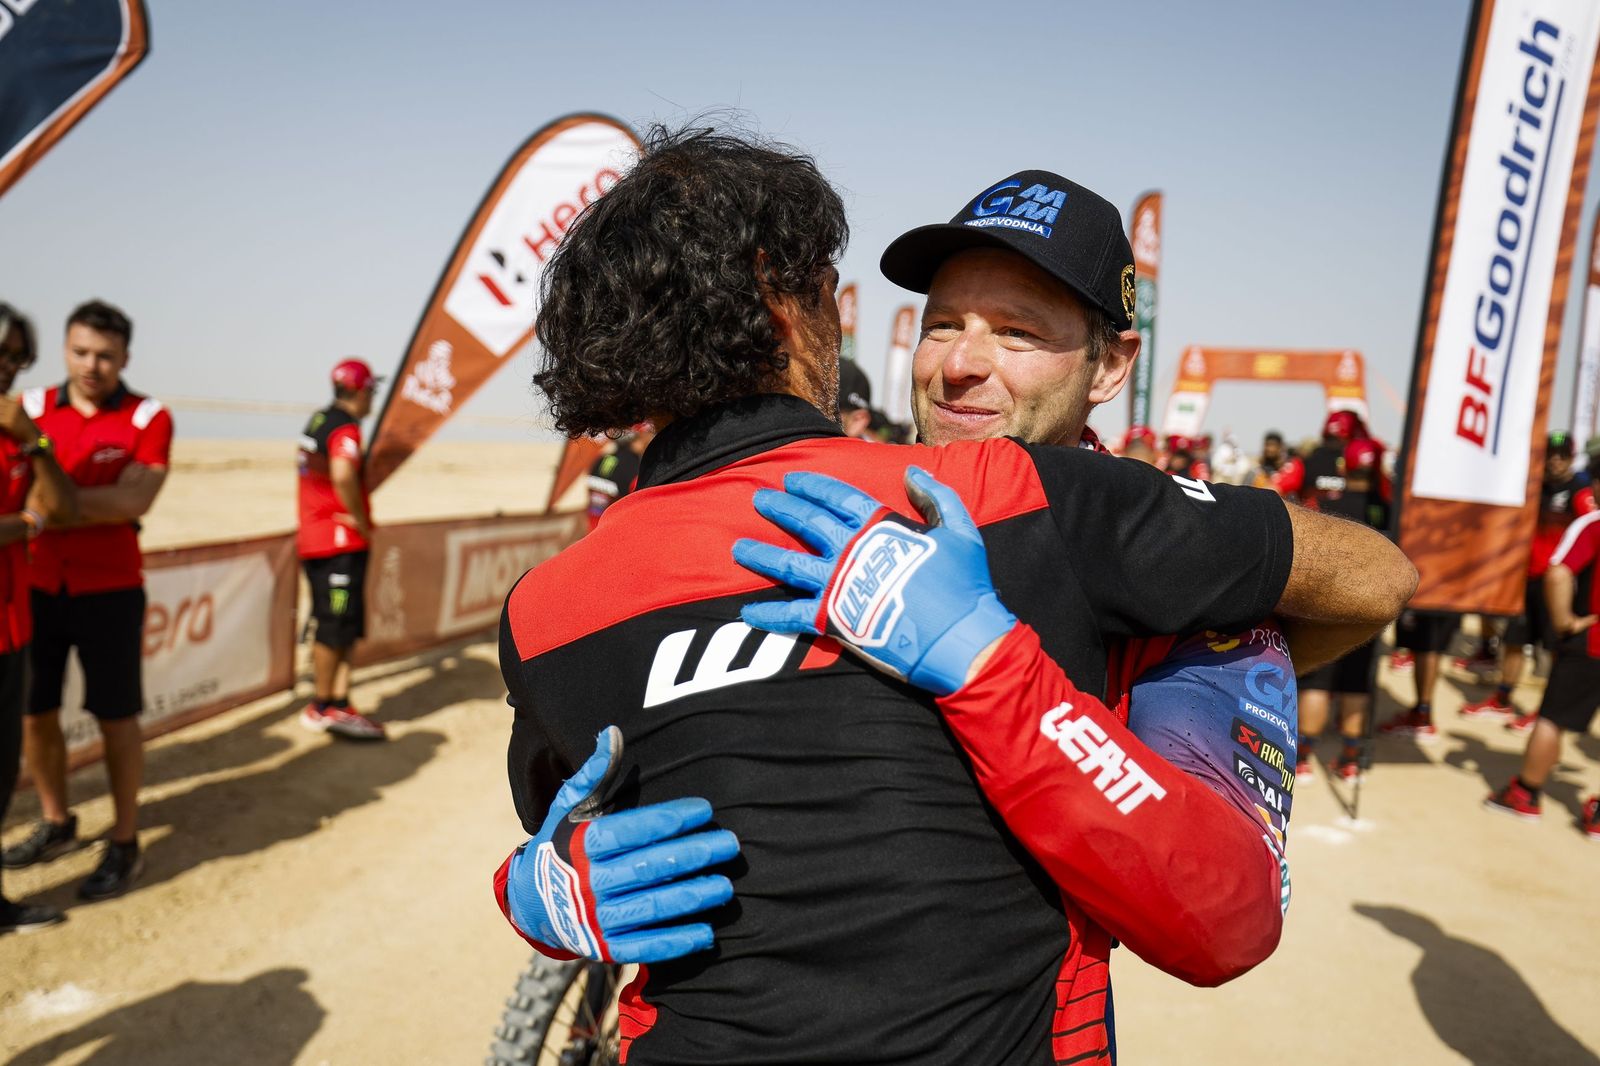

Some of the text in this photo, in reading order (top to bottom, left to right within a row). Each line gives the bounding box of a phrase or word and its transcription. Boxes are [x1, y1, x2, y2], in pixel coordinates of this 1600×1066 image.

[1456, 18, 1560, 449] BFGoodrich
[143, 591, 214, 659] ero
[1039, 701, 1168, 816] LEATT
